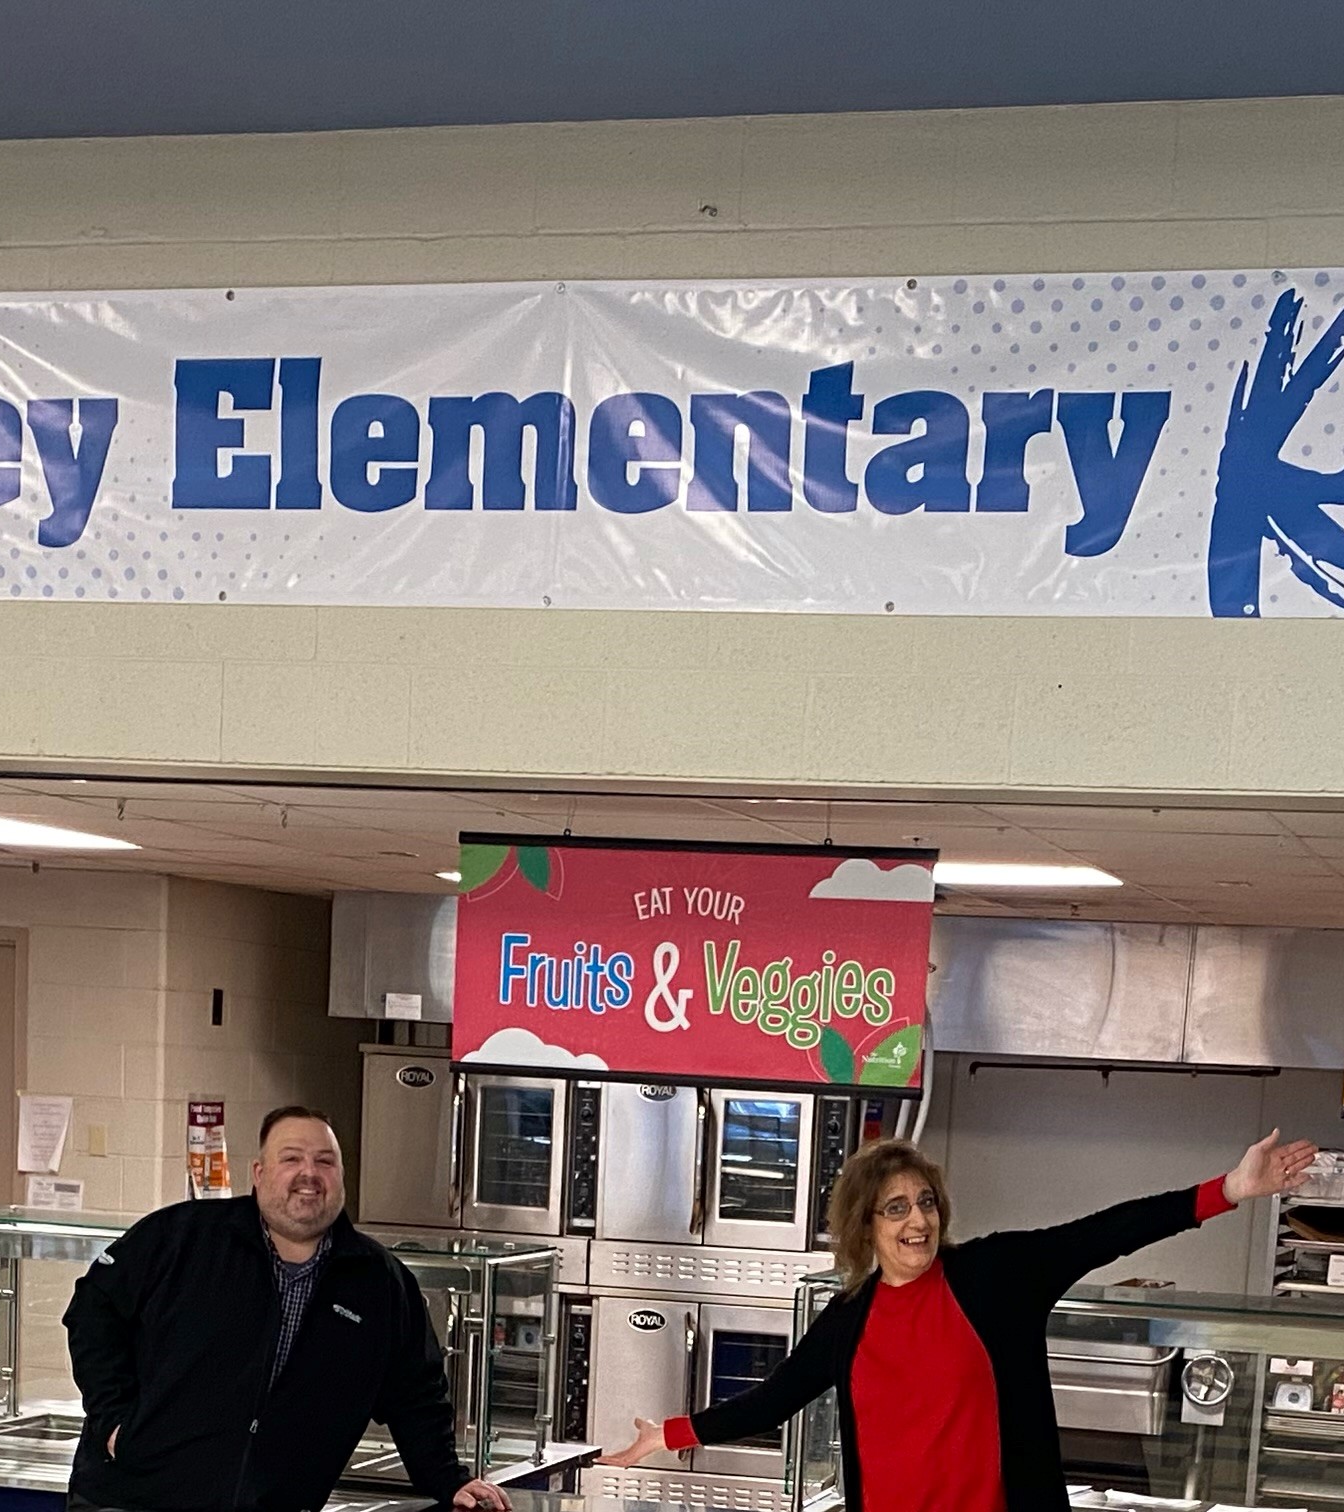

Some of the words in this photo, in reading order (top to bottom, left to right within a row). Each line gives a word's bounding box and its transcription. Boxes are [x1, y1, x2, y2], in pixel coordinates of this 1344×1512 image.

[171, 356, 1172, 558] Elementary
[633, 887, 674, 921] EAT
[683, 887, 745, 925] YOUR
[499, 933, 634, 1015] Fruits
[644, 941, 694, 1032] &
[703, 939, 896, 1049] Veggies
[401, 1070, 432, 1083] ROYAL
[641, 1084, 674, 1097] ROYAL
[631, 1314, 664, 1327] ROYAL
